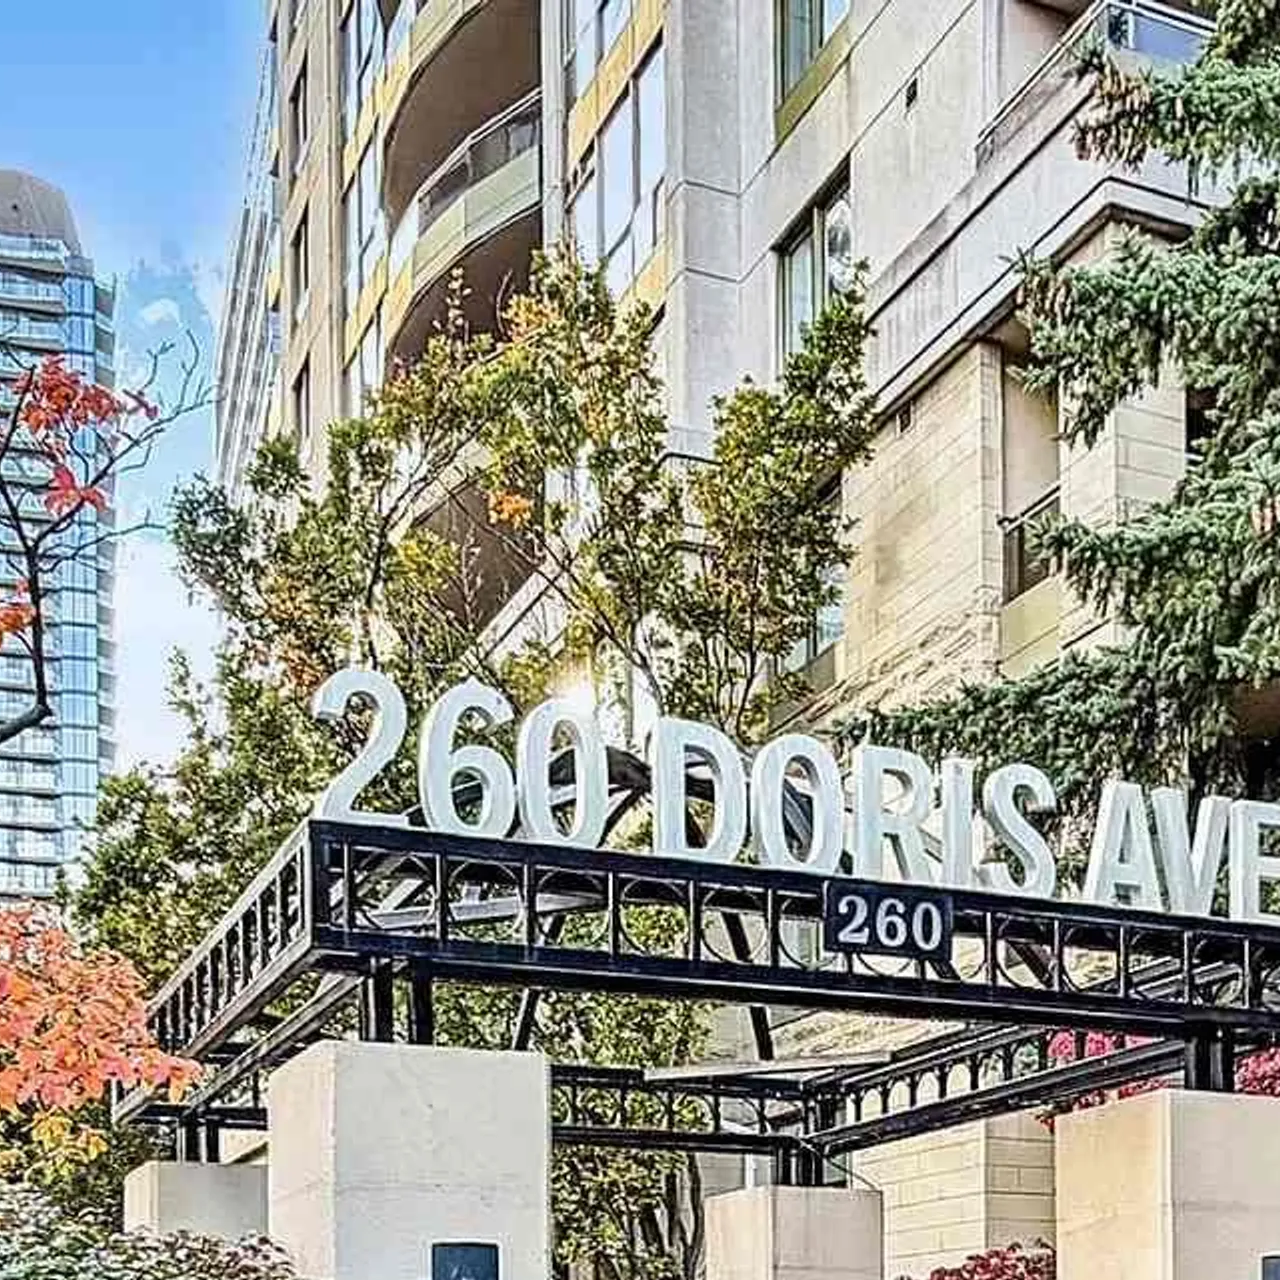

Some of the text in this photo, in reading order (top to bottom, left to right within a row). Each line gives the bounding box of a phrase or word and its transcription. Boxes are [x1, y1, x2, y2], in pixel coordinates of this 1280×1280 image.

[312, 667, 608, 849] 260
[651, 716, 1058, 898] DORIS
[837, 894, 943, 951] 260
